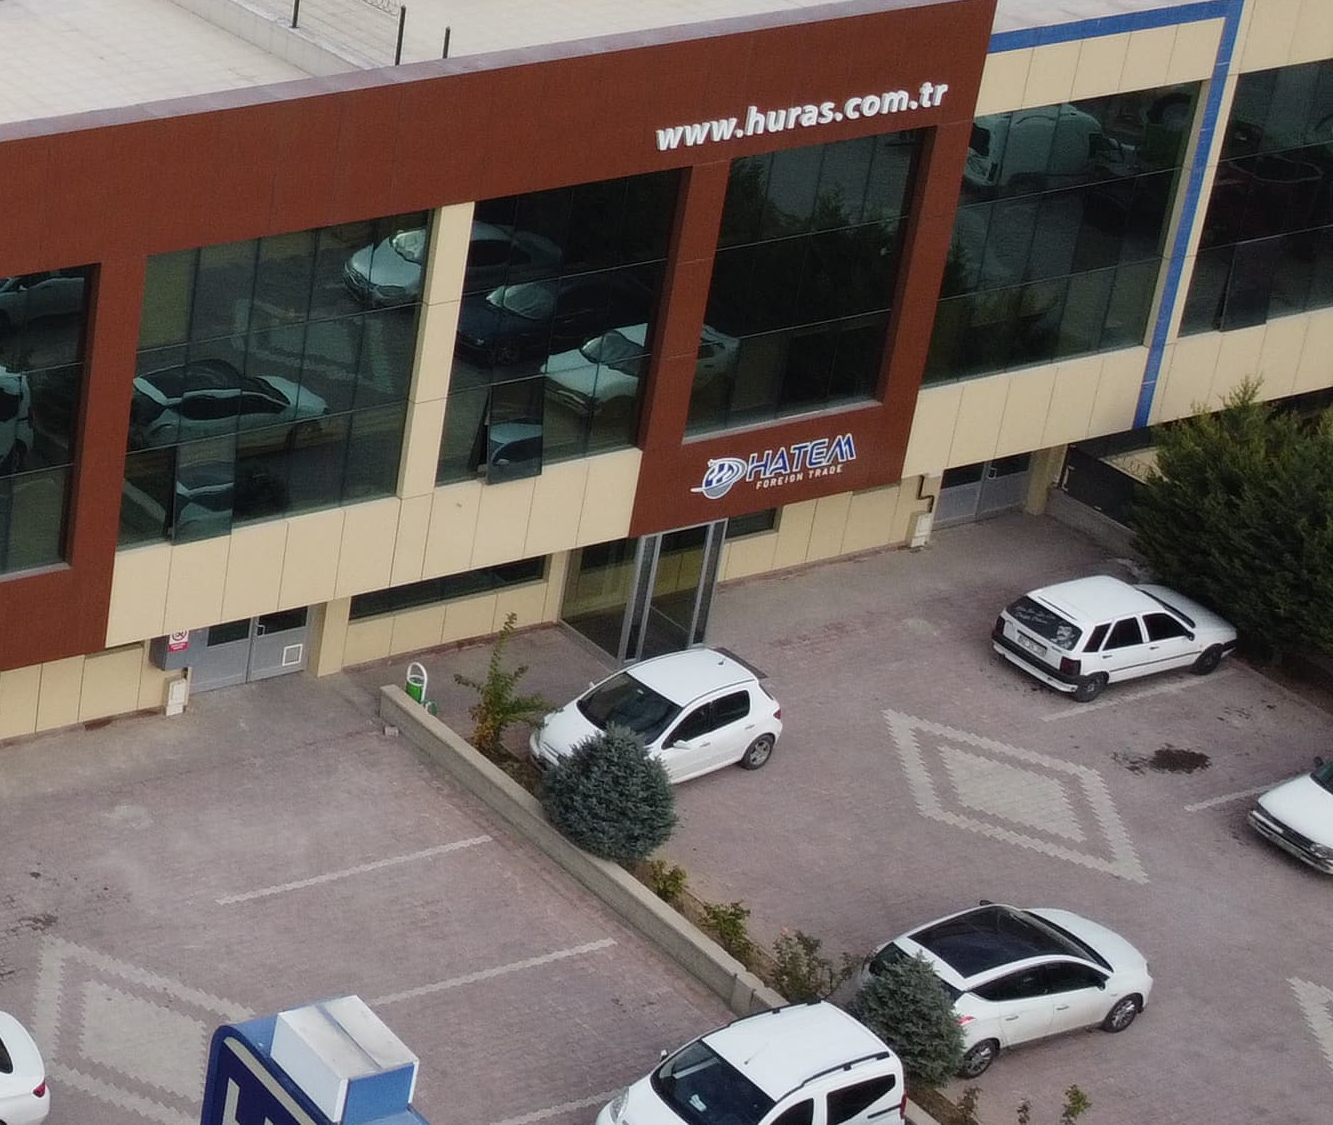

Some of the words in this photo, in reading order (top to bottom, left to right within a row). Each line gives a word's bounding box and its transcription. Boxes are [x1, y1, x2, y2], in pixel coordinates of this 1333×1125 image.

[655, 81, 949, 152] www.huras.com.tr
[745, 432, 857, 482] HATEM
[808, 464, 844, 480] TRADE
